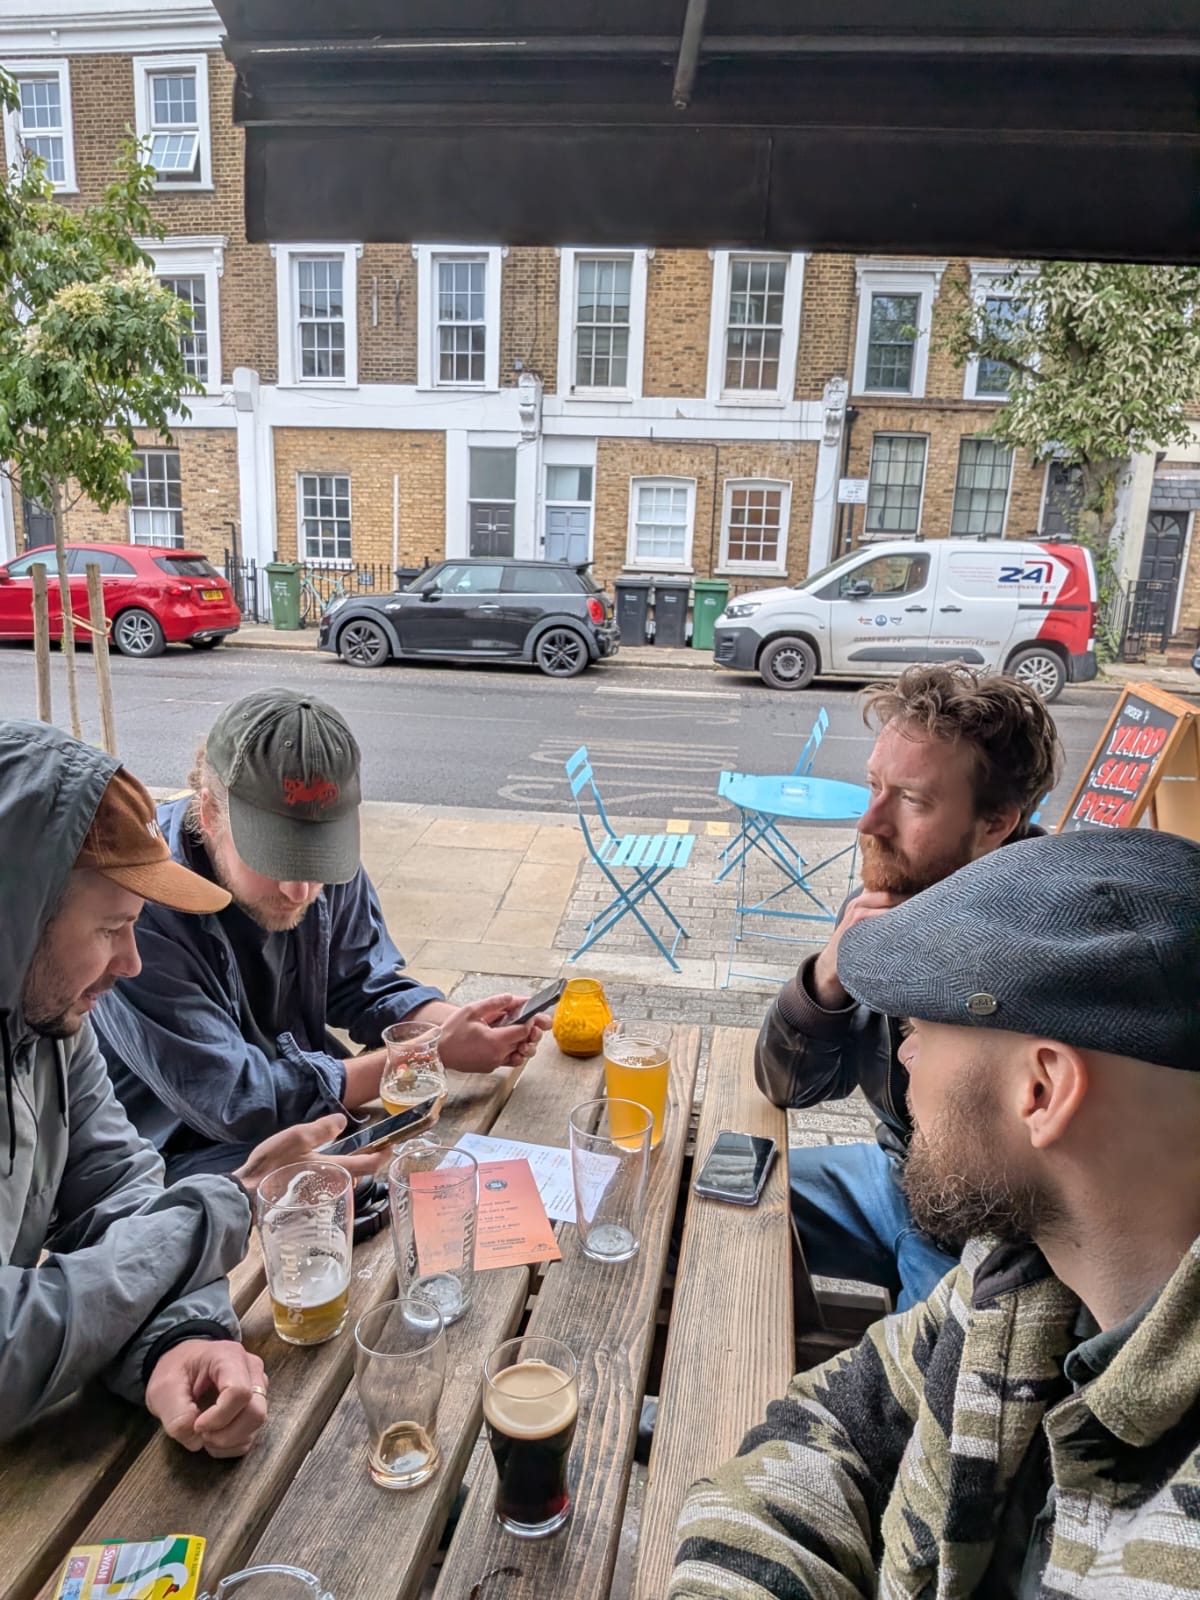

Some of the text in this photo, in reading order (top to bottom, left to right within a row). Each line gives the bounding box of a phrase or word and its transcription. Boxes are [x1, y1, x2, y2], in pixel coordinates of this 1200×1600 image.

[1106, 725, 1168, 759] YARD
[1094, 758, 1150, 794] SALE
[1072, 791, 1134, 829] PIZZA
[97, 1549, 116, 1579] SWAN
